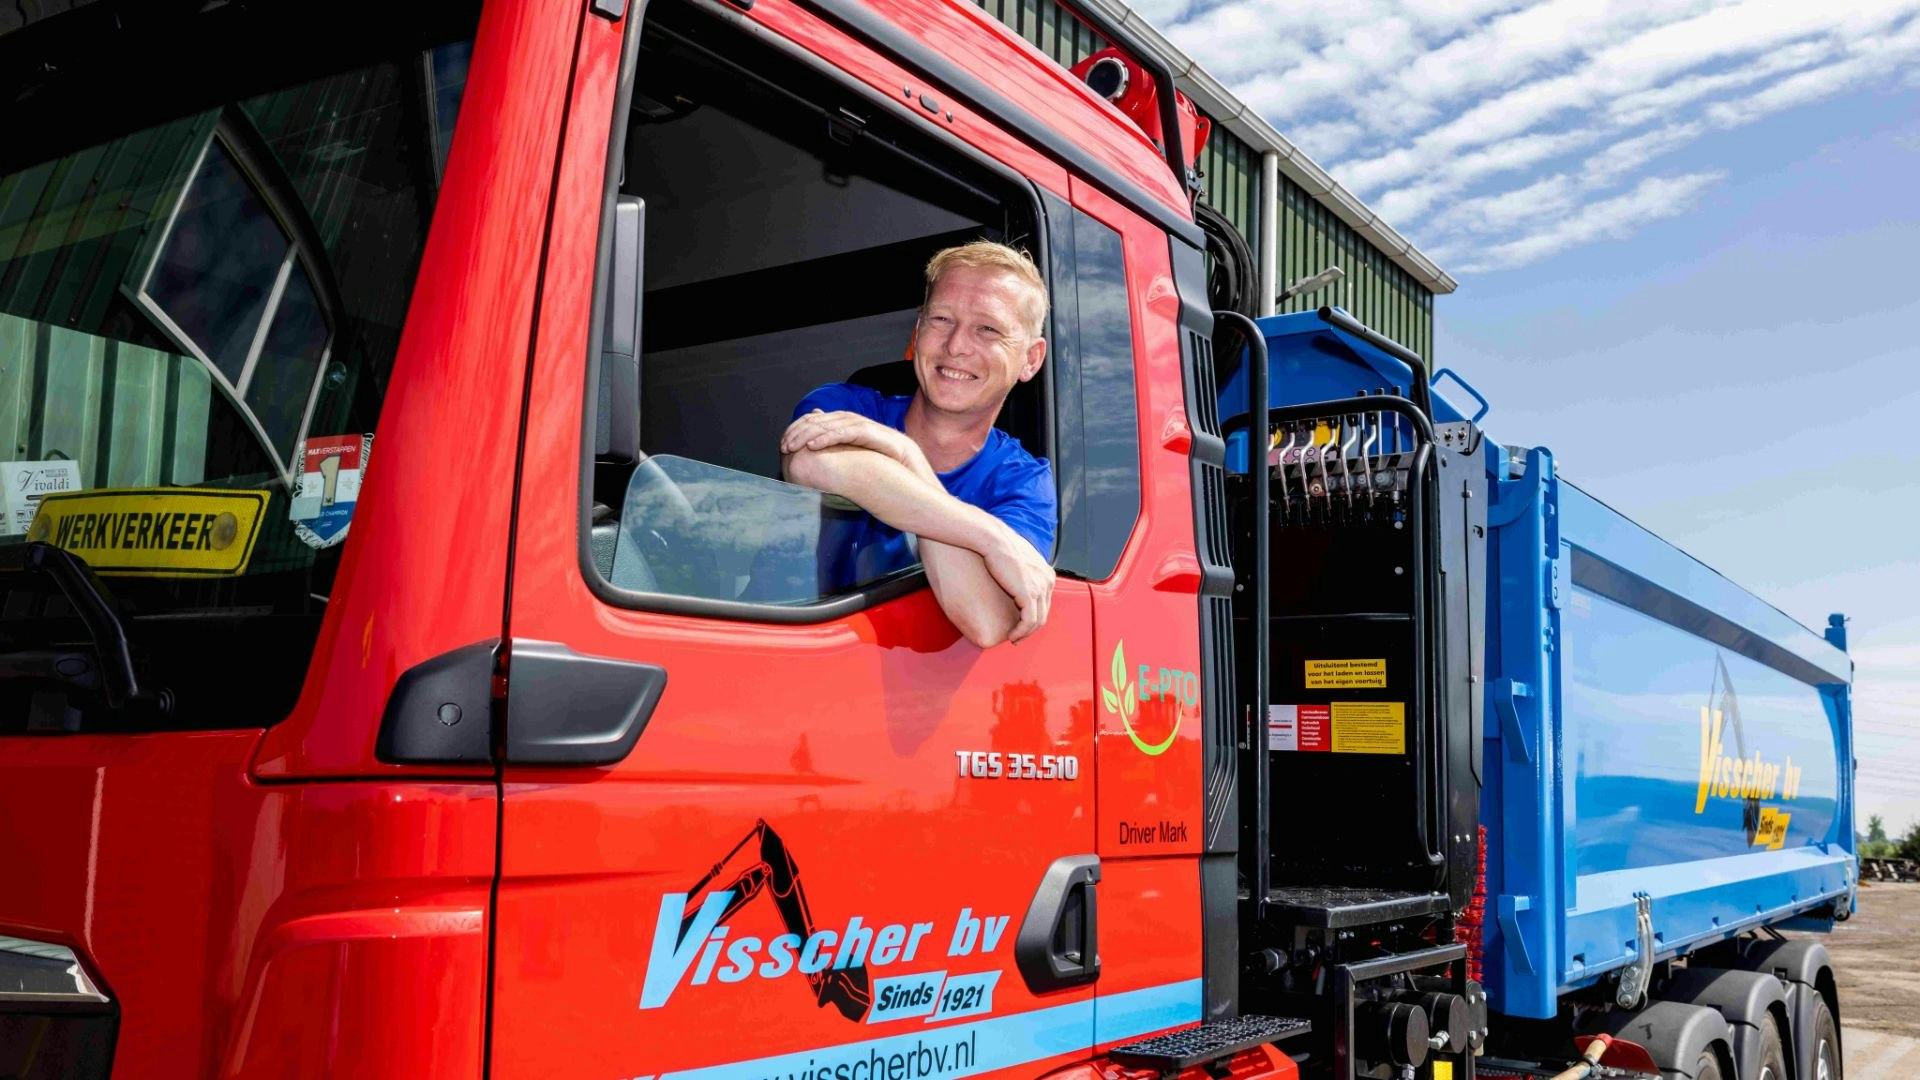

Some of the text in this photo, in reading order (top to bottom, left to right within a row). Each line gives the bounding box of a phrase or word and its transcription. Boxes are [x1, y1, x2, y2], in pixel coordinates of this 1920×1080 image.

[17, 470, 70, 492] Vivaldi
[319, 454, 341, 507] 1
[55, 512, 218, 551] WERKVERKEER
[1138, 664, 1198, 706] E-PTO
[1355, 678, 1382, 686] voertuig
[955, 751, 1079, 780] TGS 35.510
[1695, 707, 1801, 814] Visscher bv
[1119, 821, 1187, 845] Driver Mark
[639, 890, 1010, 1010] Visscher bv
[877, 981, 985, 1013] Sinds 1921
[763, 1030, 976, 1080] isscherbv.nl
